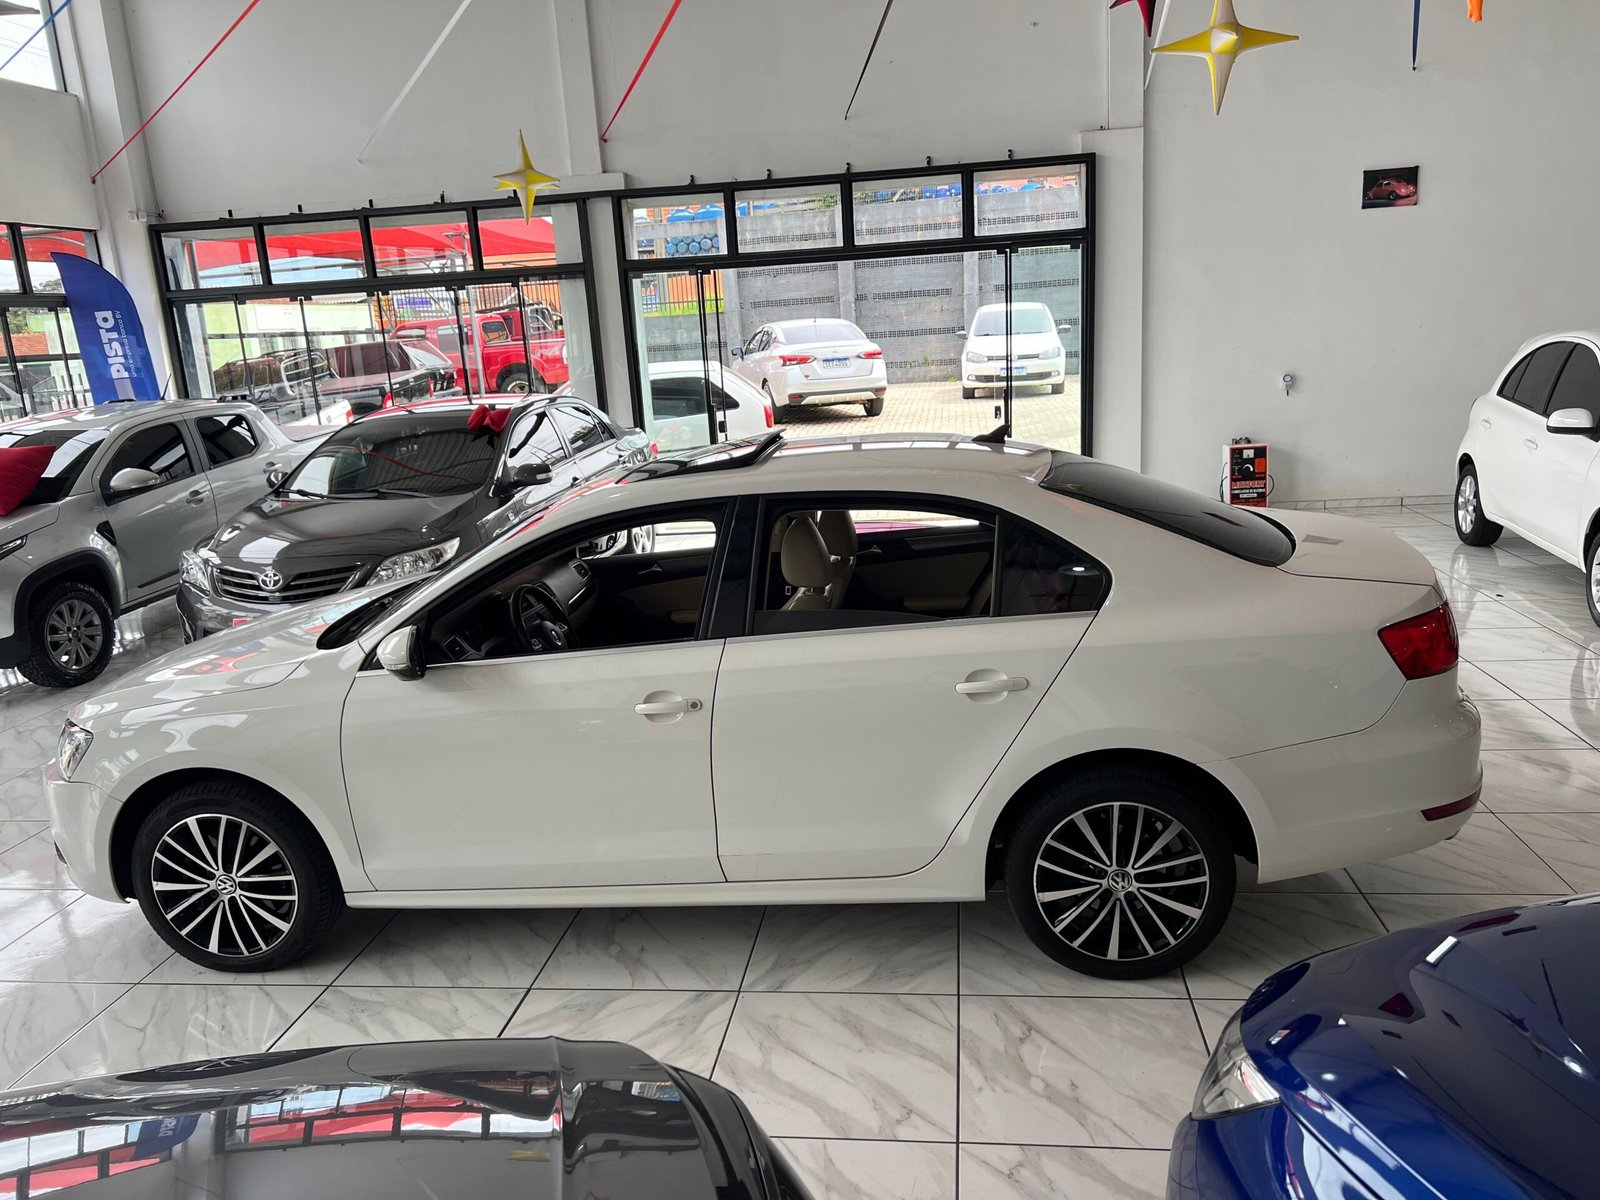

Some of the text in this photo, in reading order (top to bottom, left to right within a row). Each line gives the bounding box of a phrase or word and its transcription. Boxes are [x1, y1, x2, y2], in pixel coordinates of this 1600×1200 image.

[114, 310, 137, 378] uma empresa banco BV
